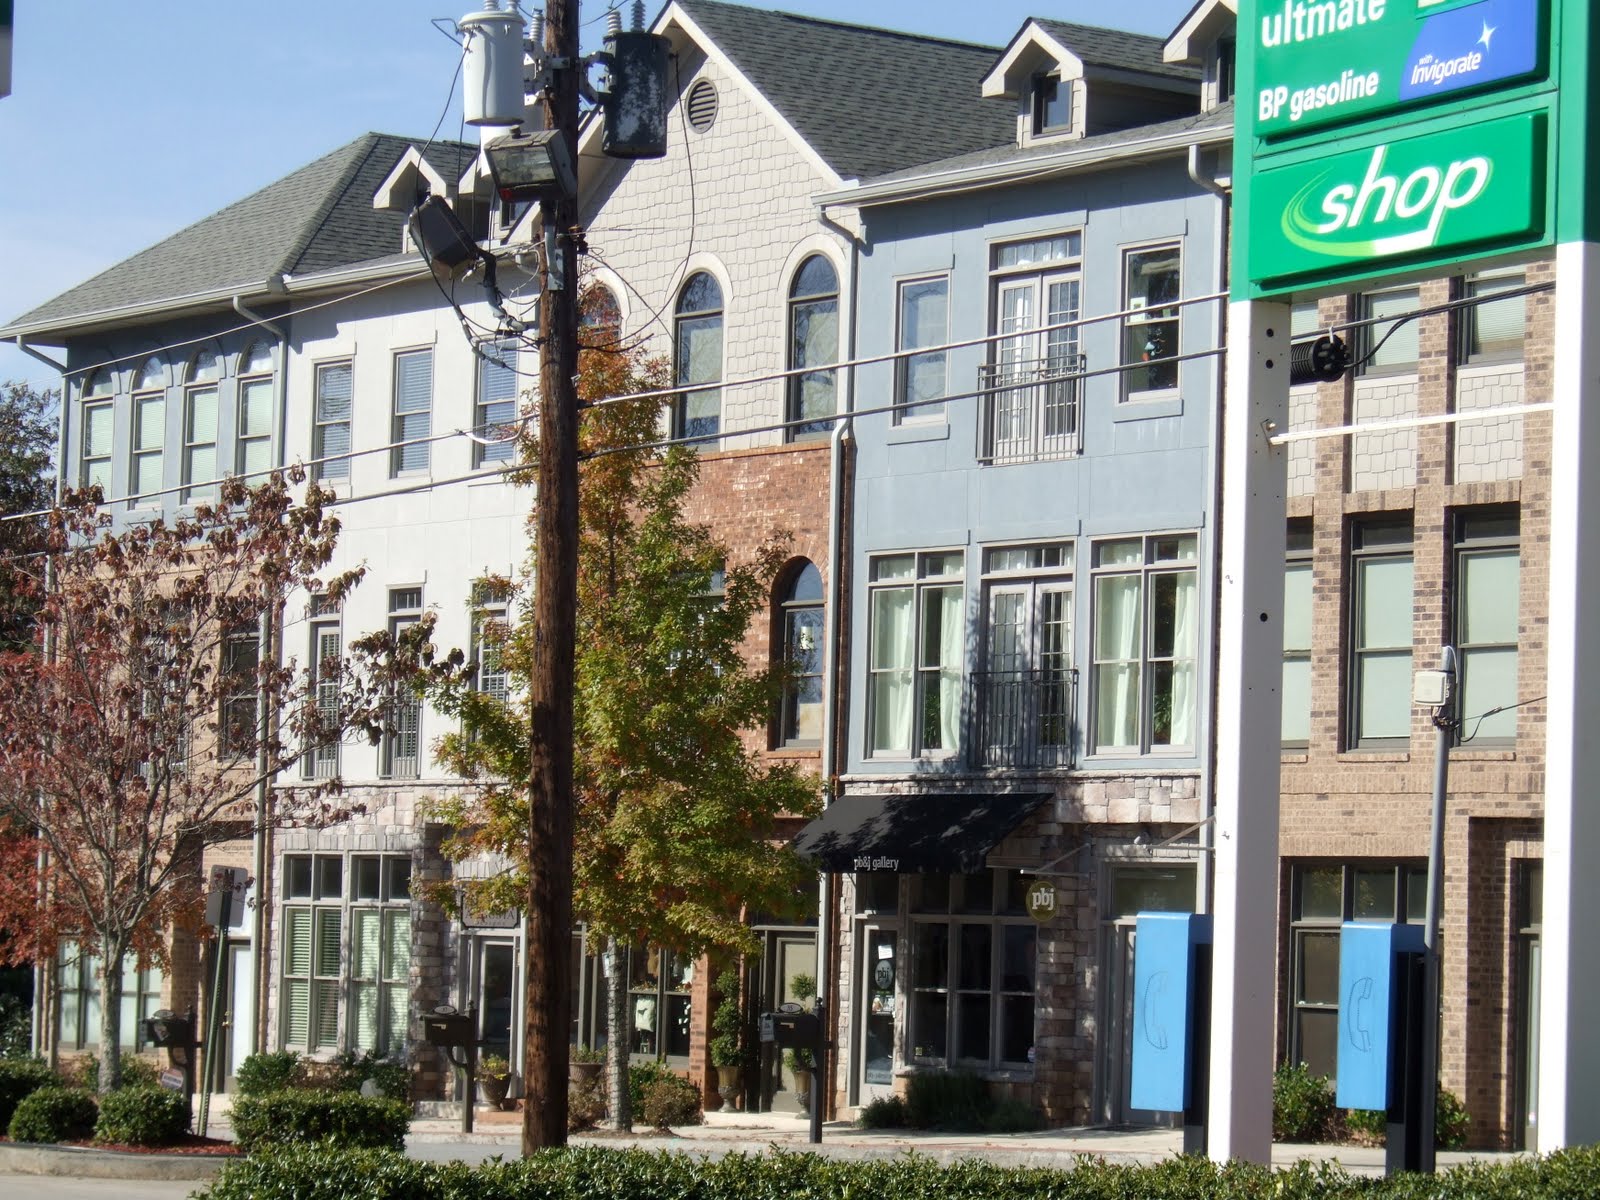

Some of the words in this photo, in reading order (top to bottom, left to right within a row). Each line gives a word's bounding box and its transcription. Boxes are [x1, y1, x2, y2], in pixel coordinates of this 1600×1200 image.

[1262, 0, 1386, 47] ultimate
[1410, 51, 1482, 86] Invigorate
[1418, 54, 1433, 65] with
[1259, 86, 1288, 121] BP
[1289, 69, 1379, 121] gasoline
[1314, 144, 1492, 254] shop
[853, 855, 871, 871] pb&j
[872, 855, 899, 871] gallery
[1031, 887, 1055, 911] pbj
[877, 966, 890, 983] pbj
